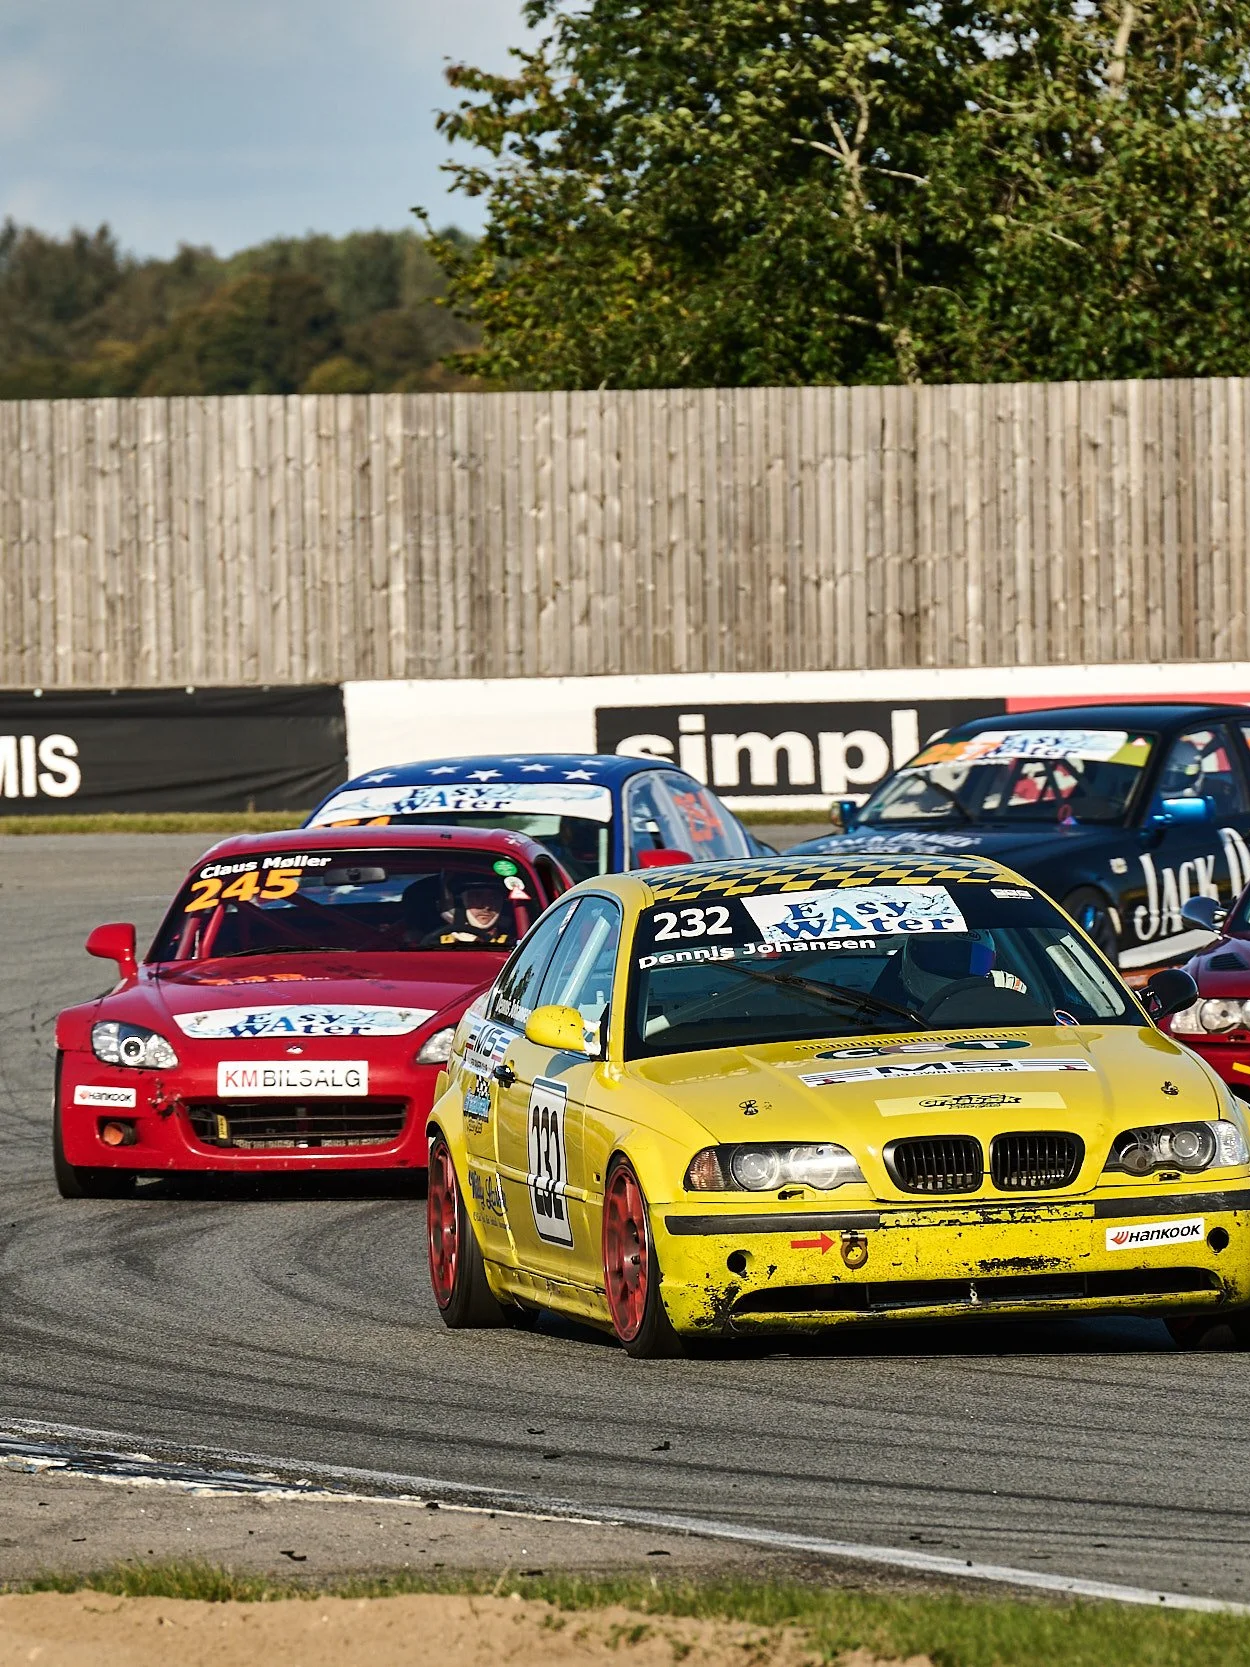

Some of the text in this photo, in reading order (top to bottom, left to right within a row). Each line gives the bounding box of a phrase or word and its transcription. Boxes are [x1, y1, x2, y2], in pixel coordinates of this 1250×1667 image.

[616, 690, 950, 794] impl
[200, 855, 332, 880] Claus Møller
[184, 869, 303, 913] 245
[1134, 854, 1220, 941] JACK
[653, 906, 733, 942] 232
[638, 937, 877, 970] Dennis Johansen
[833, 1041, 1008, 1058] CST
